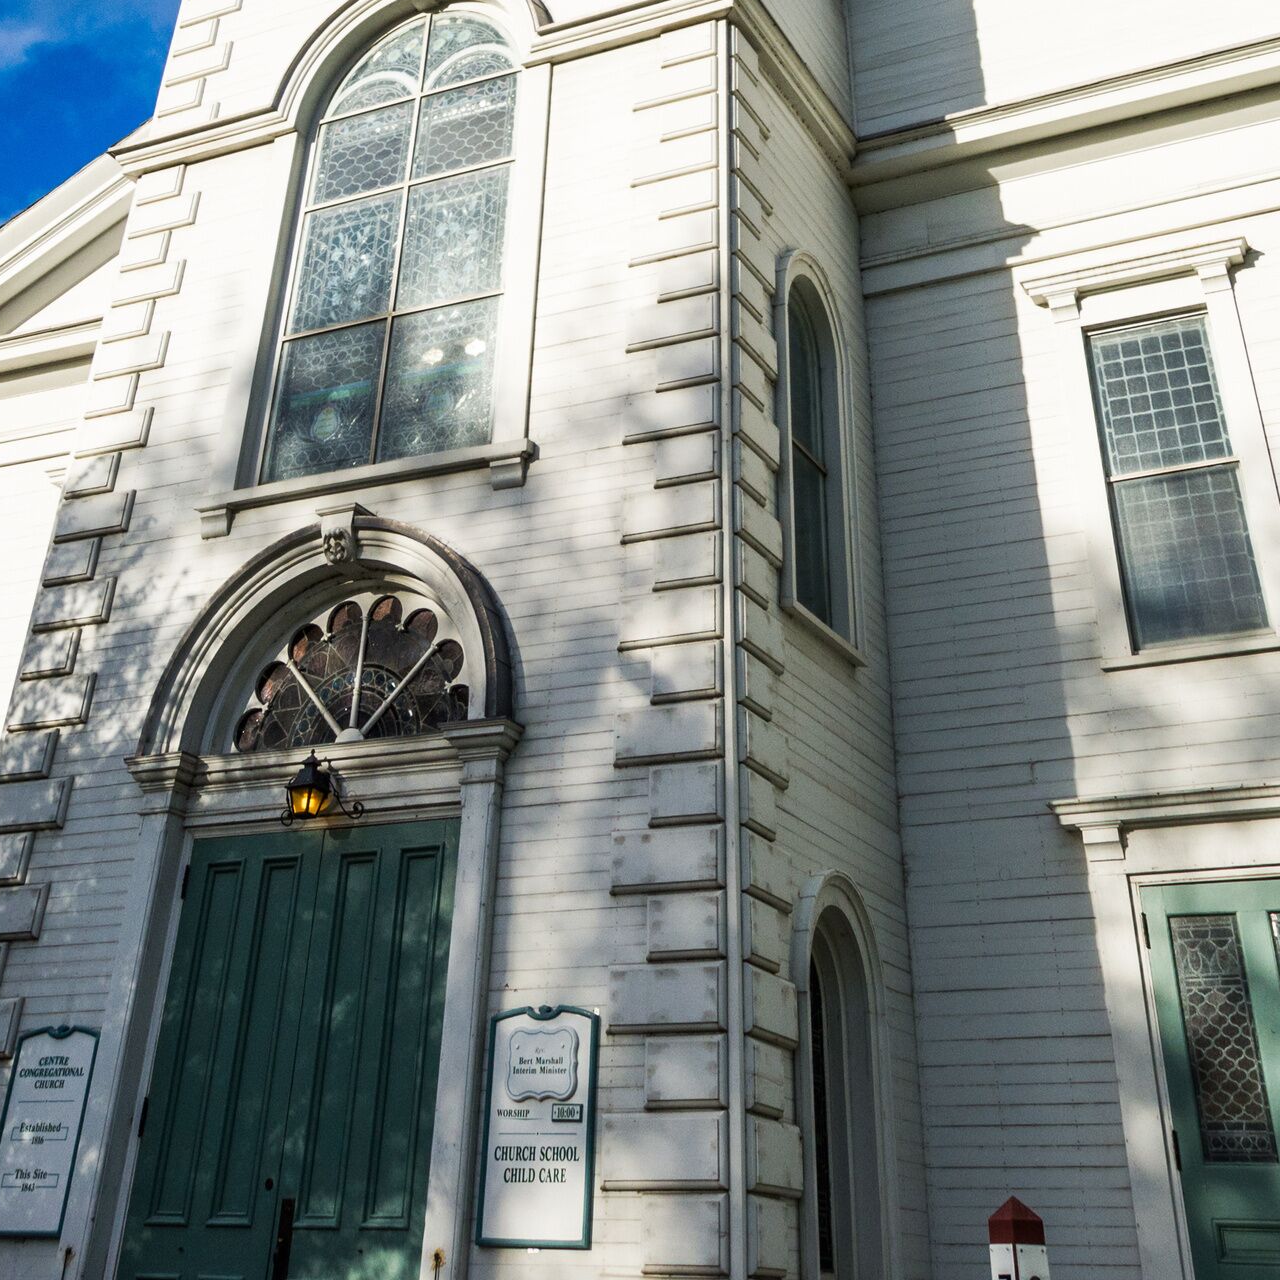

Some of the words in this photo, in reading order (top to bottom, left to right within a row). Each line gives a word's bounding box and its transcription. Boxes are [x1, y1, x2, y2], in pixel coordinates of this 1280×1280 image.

[39, 1056, 69, 1066] CENTRE
[518, 1057, 533, 1065] Bert
[535, 1056, 564, 1065] Marshall
[19, 1067, 84, 1078] CONGREGATIONAL
[512, 1066, 537, 1075] Interim
[539, 1065, 567, 1074] Minister
[34, 1079, 65, 1089] CHURCH
[496, 1109, 530, 1118] WORSHIP
[19, 1122, 62, 1133] Established
[494, 1145, 536, 1162] CHURCH
[539, 1145, 580, 1162] SCHOOL
[14, 1168, 30, 1180] This
[32, 1168, 48, 1180] Site
[503, 1167, 536, 1183] CHILD
[538, 1167, 567, 1183] CARE
